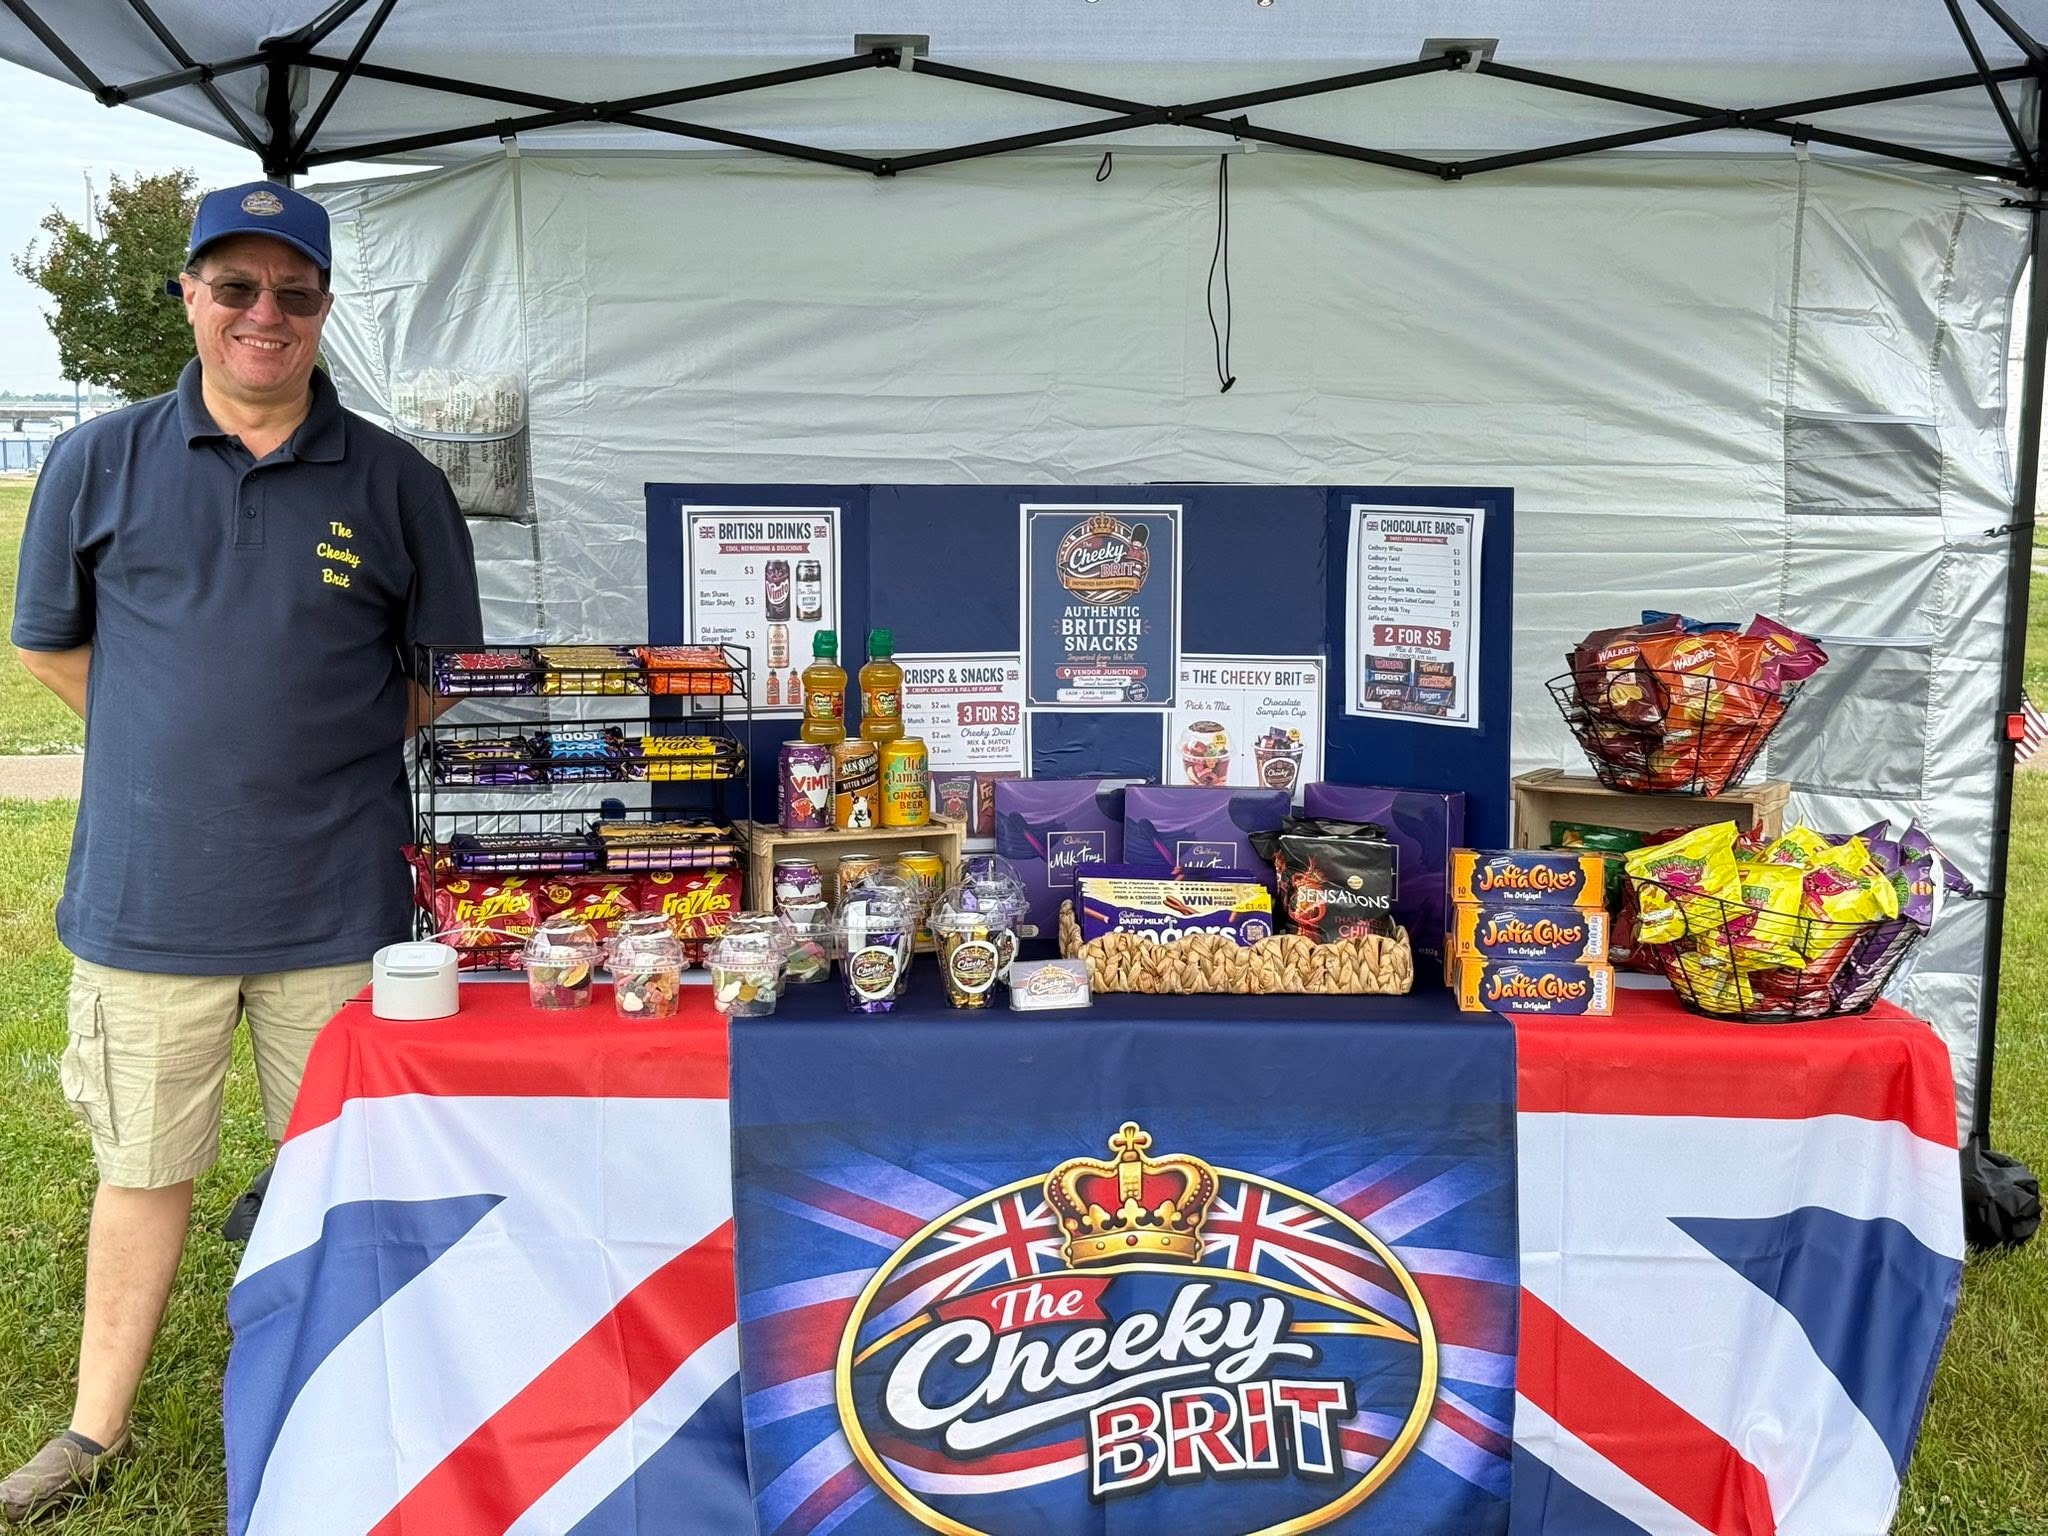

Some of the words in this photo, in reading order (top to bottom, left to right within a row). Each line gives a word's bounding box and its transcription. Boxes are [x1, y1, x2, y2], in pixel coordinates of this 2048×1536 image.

[329, 521, 353, 538] The
[719, 523, 763, 539] BRITISH
[767, 523, 811, 539] DRINKS
[1380, 519, 1432, 534] CHOCOLATE
[1434, 522, 1456, 536] BARS
[316, 542, 361, 568] Cheeky
[1069, 542, 1127, 569] Cheeky
[744, 566, 754, 575] $3
[1100, 562, 1135, 577] BRIT
[321, 568, 350, 588] Brit
[716, 599, 736, 607] Shandy
[744, 597, 755, 605] $3
[1064, 606, 1139, 617] AUTHENTIC
[701, 626, 711, 634] Old
[712, 626, 737, 634] Jamaican
[1061, 619, 1142, 635] BRITISH
[745, 631, 755, 639] $3
[1385, 627, 1393, 642] 2
[1398, 629, 1421, 644] FOR
[1426, 630, 1441, 646] $5
[1064, 637, 1138, 651] SNACKS
[1672, 648, 1716, 671] WALKERS
[904, 669, 944, 684] CRISPS
[948, 669, 957, 684] &
[961, 668, 1004, 683] SNACKS
[1193, 670, 1217, 684] THE
[1221, 671, 1271, 685] CHEEKY
[1275, 671, 1302, 686] BRIT
[1375, 673, 1404, 682] BOOST
[1376, 687, 1401, 697] fingers
[1184, 699, 1204, 710] Pick
[1213, 701, 1231, 711] Mix
[1263, 697, 1301, 706] Chocolate
[964, 706, 973, 722] 3
[976, 707, 997, 722] FOR
[1001, 705, 1016, 723] $5
[1256, 707, 1289, 718] Sampler
[1291, 707, 1307, 718] Cup
[552, 731, 599, 742] BOOST
[961, 727, 990, 737] Cheeky
[992, 727, 1016, 737] Deal!
[843, 780, 861, 790] BITTER
[893, 790, 925, 800] GINGE
[900, 800, 923, 809] BEER
[1050, 850, 1078, 868] Milk
[1077, 845, 1103, 863] Tray
[1480, 864, 1529, 891] Jaffa
[1529, 864, 1577, 892] Cakes
[550, 888, 569, 900] 49p
[1457, 886, 1466, 894] 10
[1515, 891, 1542, 901] Original
[456, 880, 531, 922] Frazzles
[661, 877, 732, 919] Frazzles
[1183, 896, 1213, 906] WIN
[1298, 887, 1390, 909] SENSATIONS
[1483, 919, 1533, 946] Jaffa
[1534, 919, 1582, 947] Cakes
[1461, 942, 1470, 950] 10
[1507, 947, 1518, 955] The
[1519, 946, 1546, 957] Original
[856, 964, 885, 976] Cheeky
[957, 959, 986, 970] Cheeky
[1030, 978, 1067, 993] Cheeky
[1487, 974, 1537, 1001] Jaffa
[1538, 973, 1586, 1001] Cakes
[1465, 996, 1474, 1004] 10
[1512, 1001, 1523, 1009] The
[1523, 1001, 1551, 1011] Original
[989, 1281, 1083, 1329] The
[886, 1283, 1314, 1431] Cheeky
[1090, 1379, 1348, 1496] BRIT
